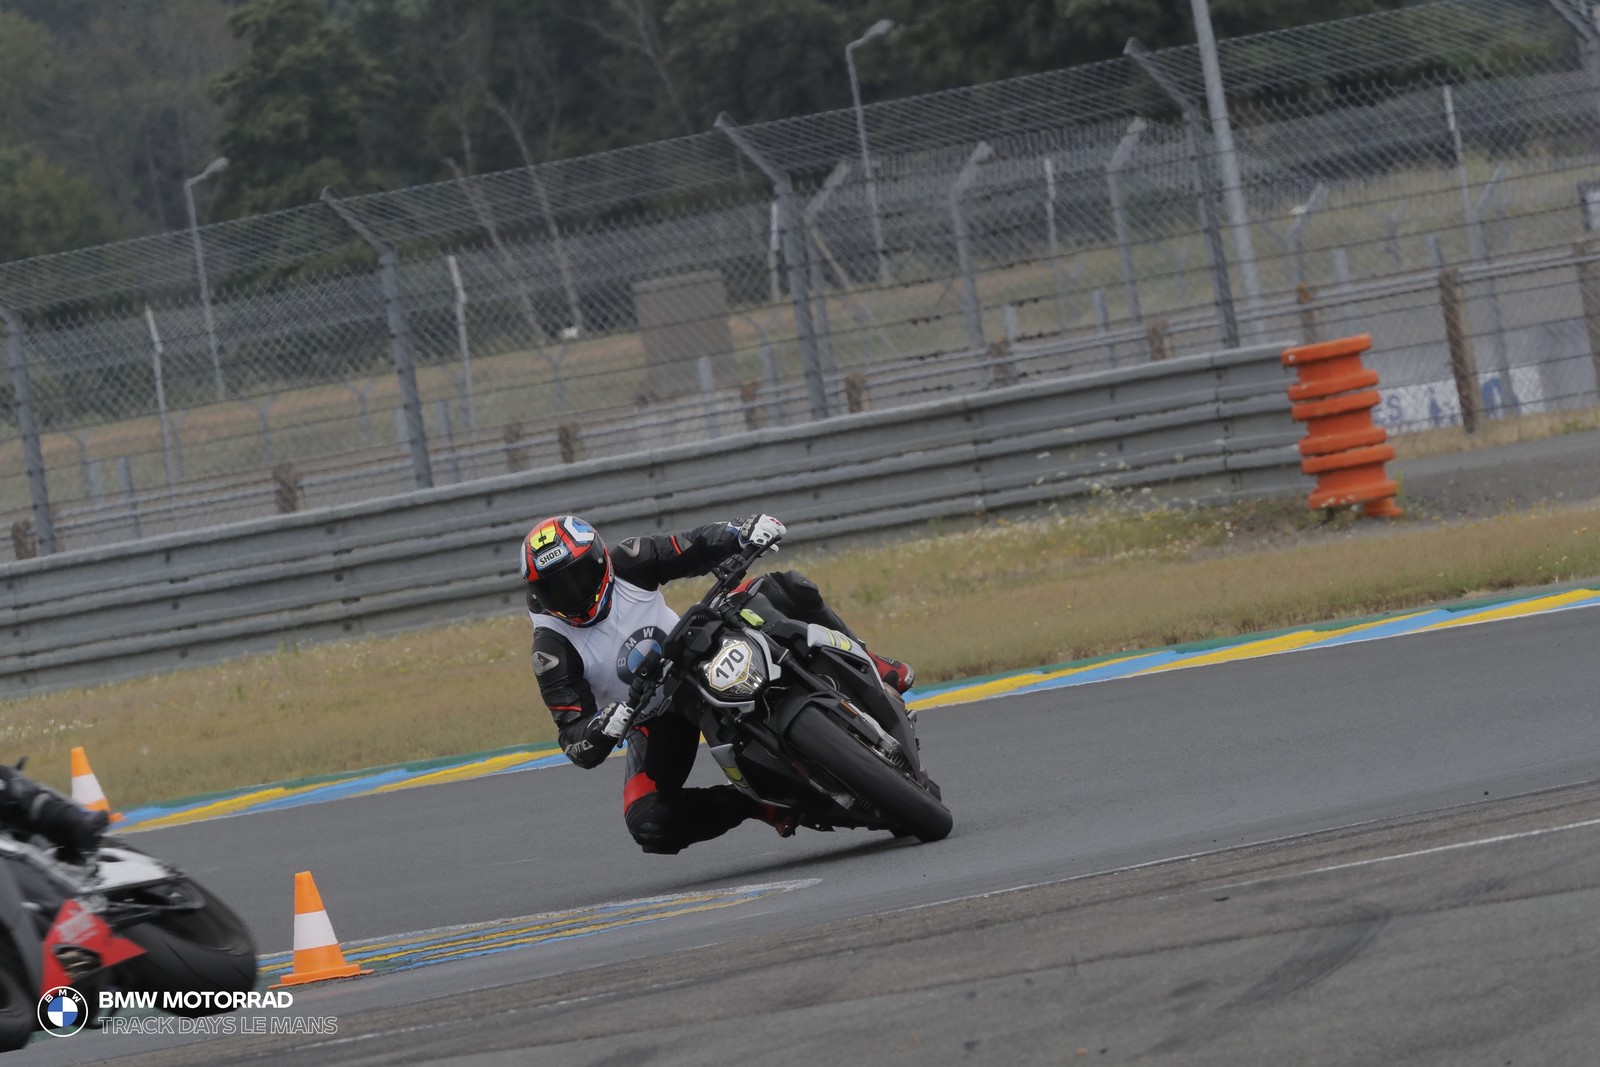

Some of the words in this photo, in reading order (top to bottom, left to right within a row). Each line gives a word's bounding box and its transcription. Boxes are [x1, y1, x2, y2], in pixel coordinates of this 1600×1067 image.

[539, 548, 562, 566] SHOEI
[617, 627, 655, 667] BMW
[715, 648, 745, 679] 170
